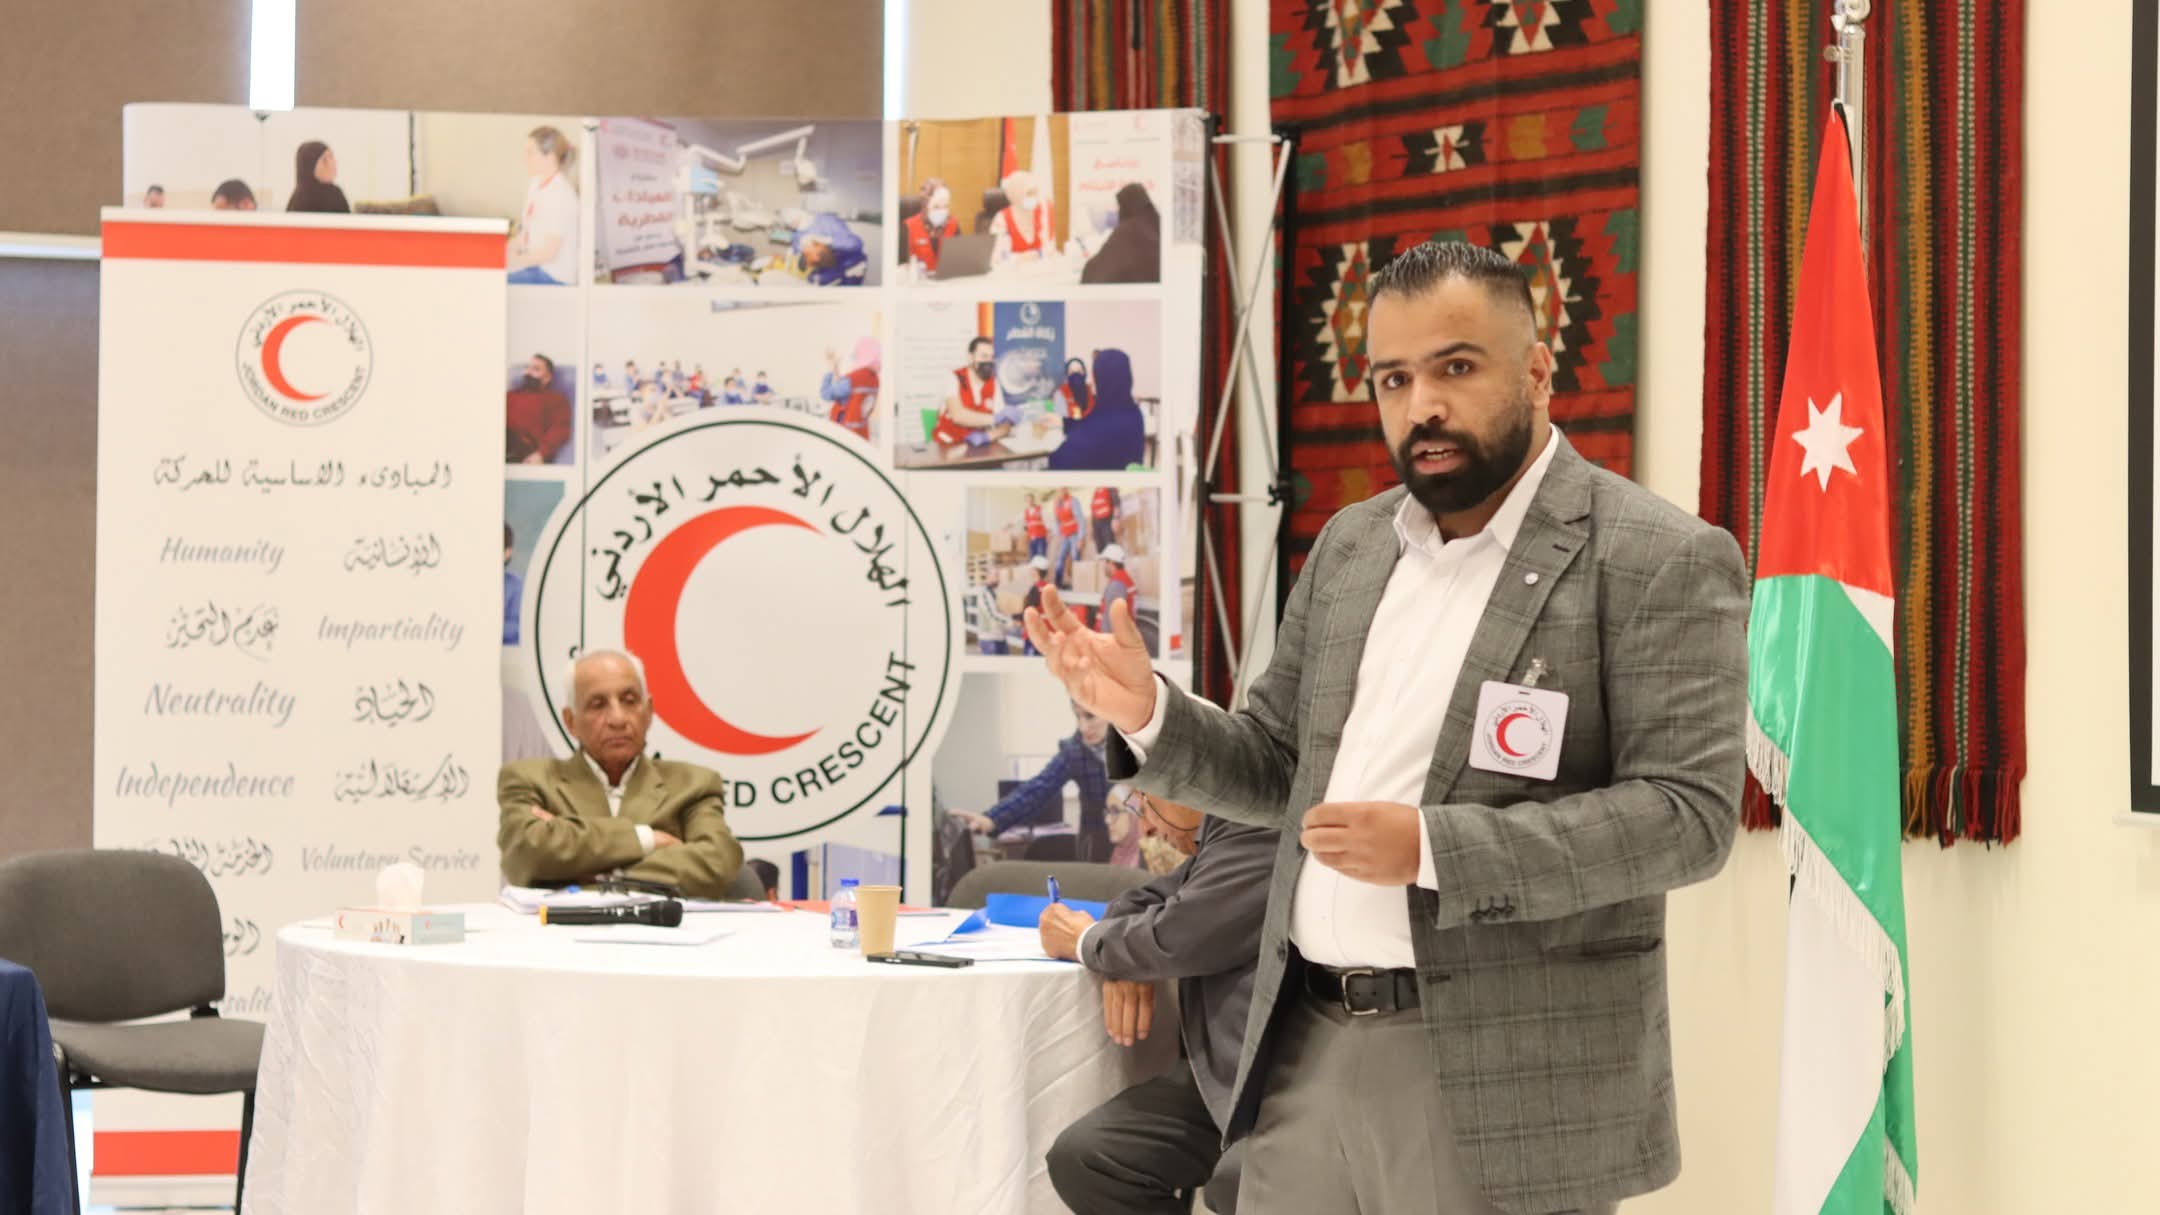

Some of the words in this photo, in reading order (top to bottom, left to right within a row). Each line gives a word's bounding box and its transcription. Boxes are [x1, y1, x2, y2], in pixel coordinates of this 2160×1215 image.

[242, 361, 278, 411] JORDAN
[281, 405, 310, 421] RED
[312, 365, 364, 419] CRESCENT
[697, 452, 835, 507] الأحمر
[160, 536, 285, 575] Humanity
[591, 473, 686, 602] الأردني
[829, 506, 912, 608] الهلال
[317, 612, 465, 651] Impartiality
[144, 680, 296, 728] Neutrality
[770, 651, 916, 804] CRESCENT
[115, 760, 295, 809] Independence
[407, 844, 480, 872] Service
